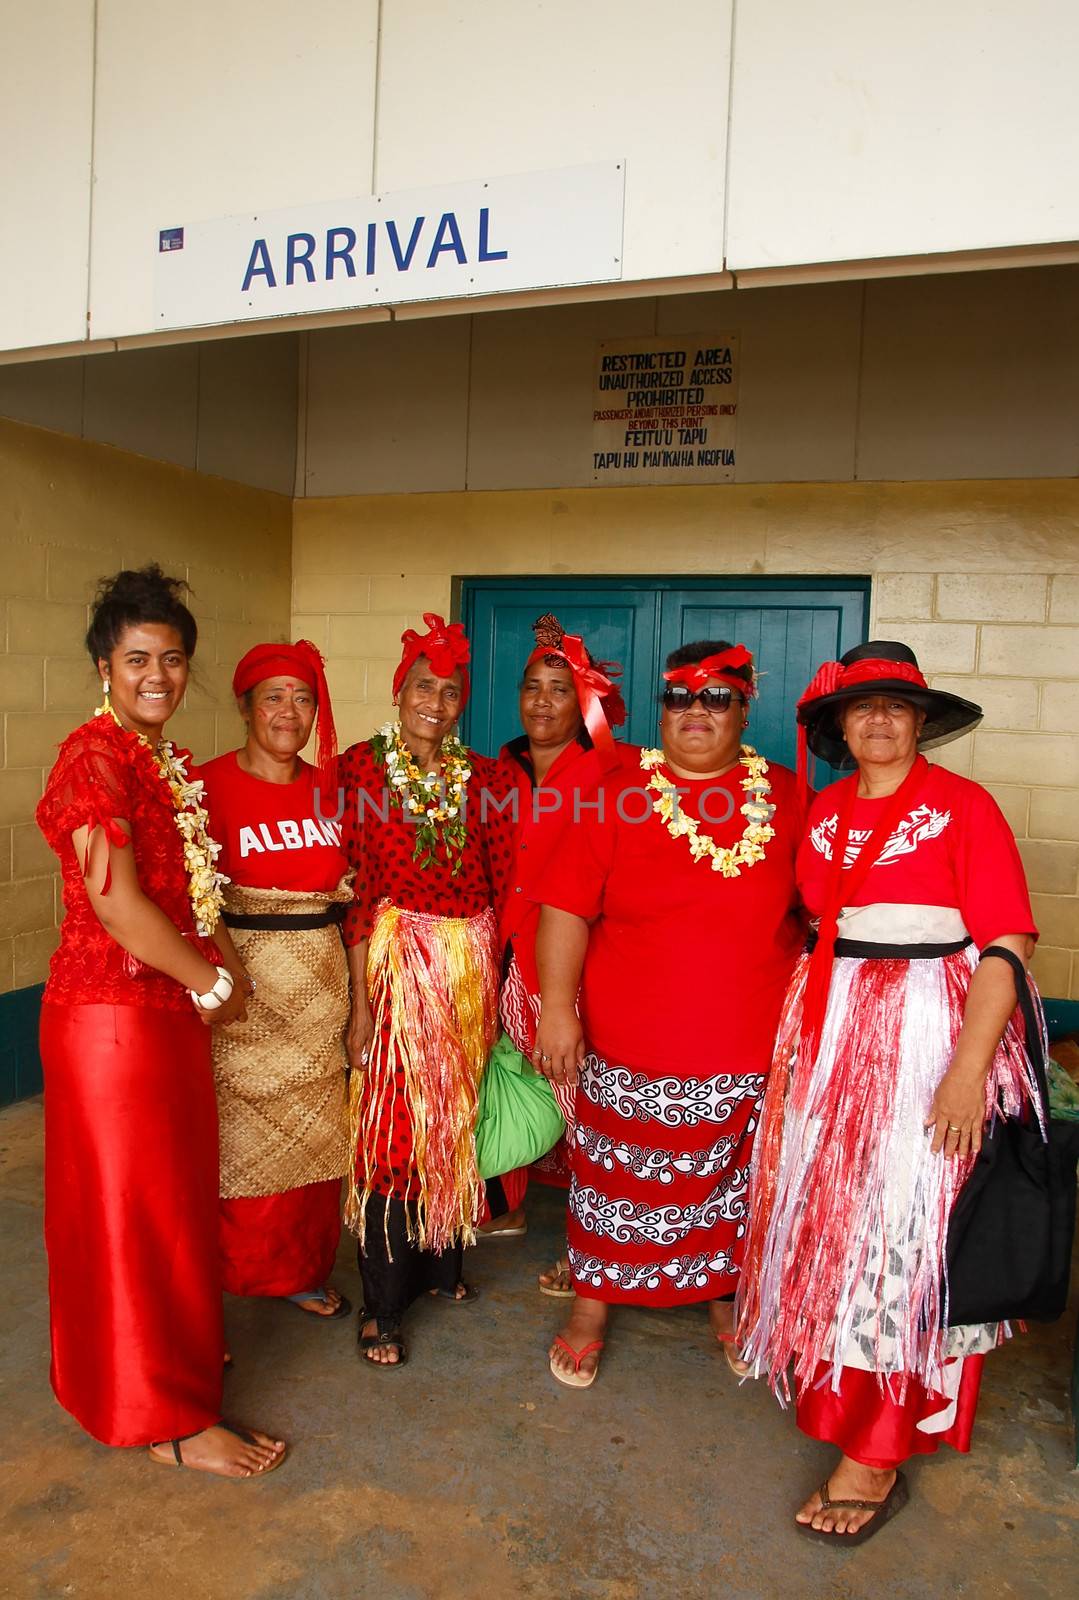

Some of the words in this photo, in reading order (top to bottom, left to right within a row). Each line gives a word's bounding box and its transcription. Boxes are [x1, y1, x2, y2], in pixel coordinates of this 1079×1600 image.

[241, 208, 508, 291] ARRIVAL
[602, 351, 686, 372] RESTRICTED
[694, 348, 732, 366] AREA
[599, 371, 684, 390] UNAUTHORIZED
[690, 368, 732, 385] ACCESS
[627, 388, 704, 408] PROHIBITED
[687, 405, 718, 417] PERSONS
[719, 404, 737, 416] ONLY
[628, 419, 659, 430] BEYOND
[661, 418, 679, 429] THIS
[681, 417, 704, 428] POINT
[677, 428, 707, 445] TAPU
[593, 452, 621, 469] TAPU
[623, 452, 639, 468] HU
[697, 449, 735, 467] NGOFUA
